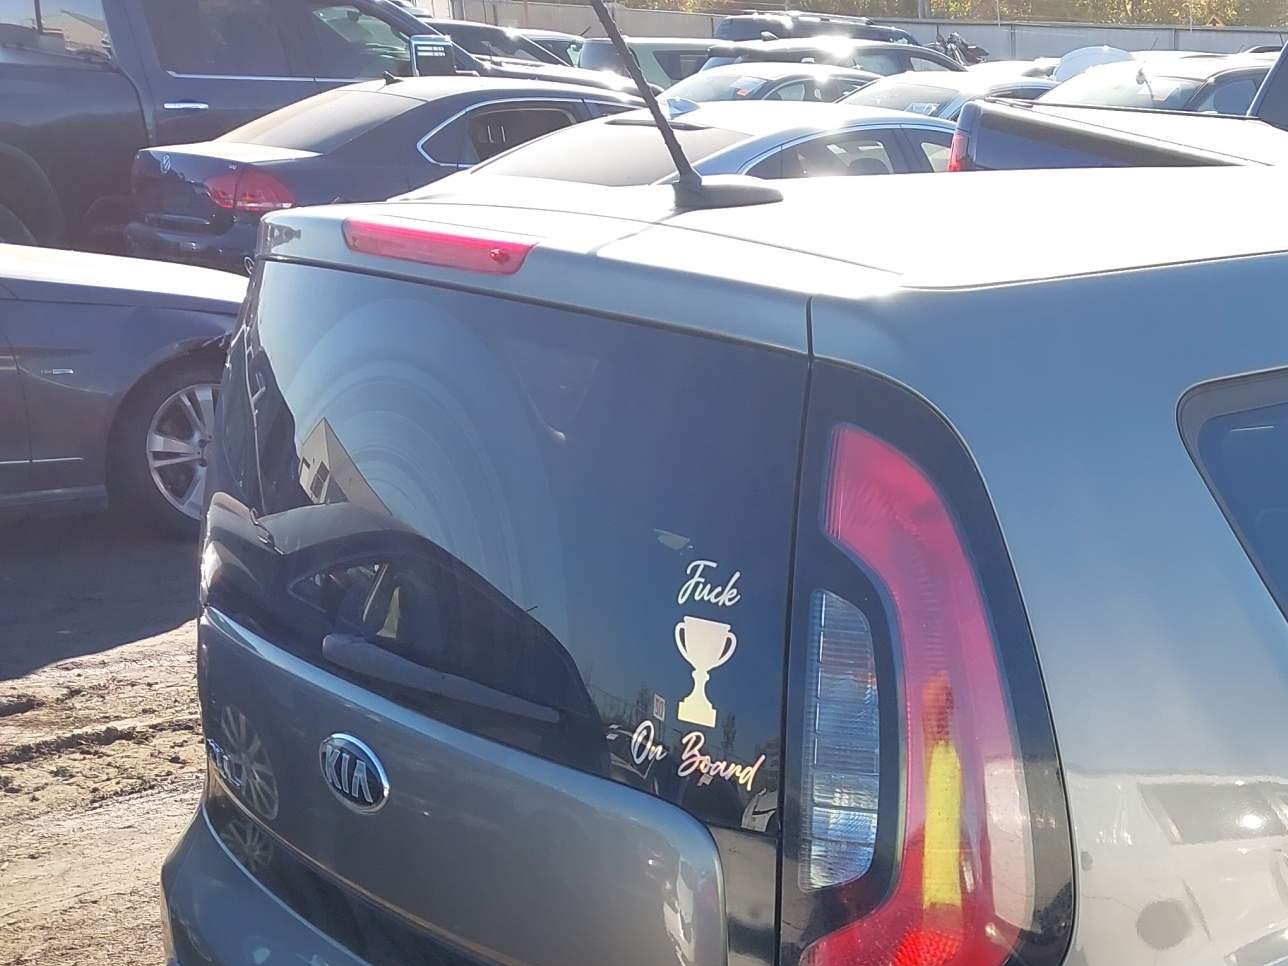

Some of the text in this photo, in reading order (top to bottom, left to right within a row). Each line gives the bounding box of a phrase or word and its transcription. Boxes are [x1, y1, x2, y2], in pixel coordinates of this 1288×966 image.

[678, 559, 741, 607] Fuck
[325, 743, 374, 804] KIA
[630, 720, 766, 792] On Board
